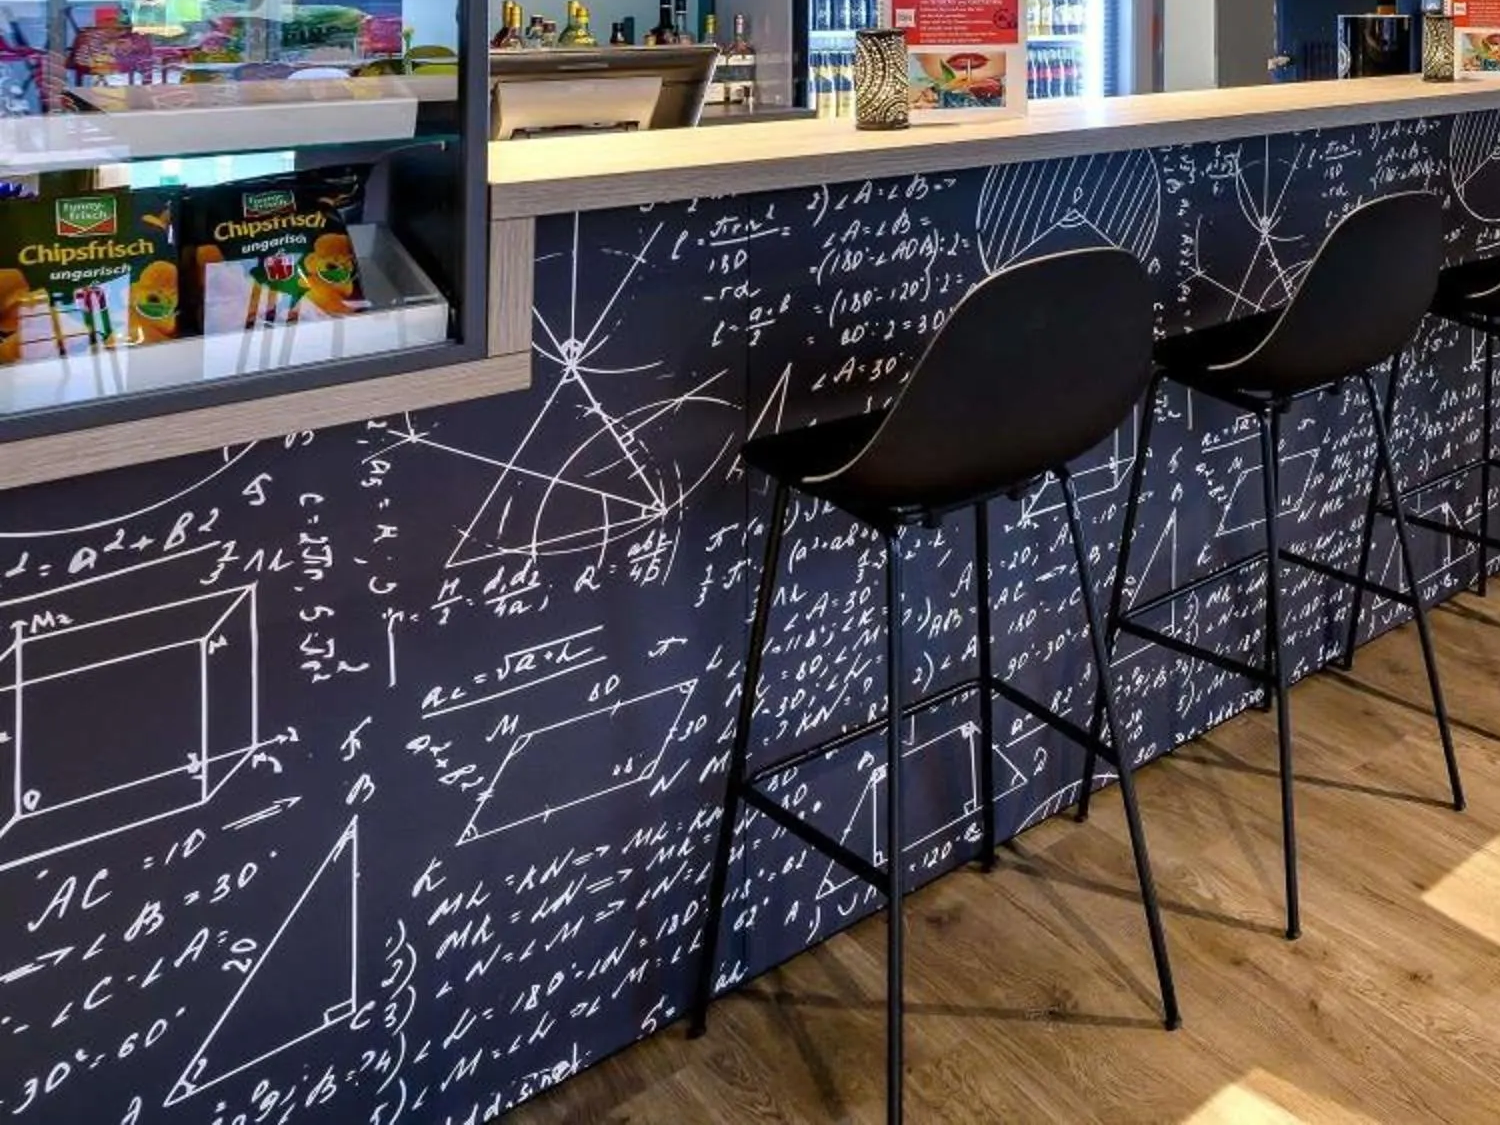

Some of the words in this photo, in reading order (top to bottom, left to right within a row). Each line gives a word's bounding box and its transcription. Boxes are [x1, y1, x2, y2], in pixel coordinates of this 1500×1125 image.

[213, 210, 327, 241] Chipsfrisch
[18, 238, 155, 266] Chipsfrisch
[241, 233, 307, 254] ungarisch
[50, 262, 131, 281] ungarisch
